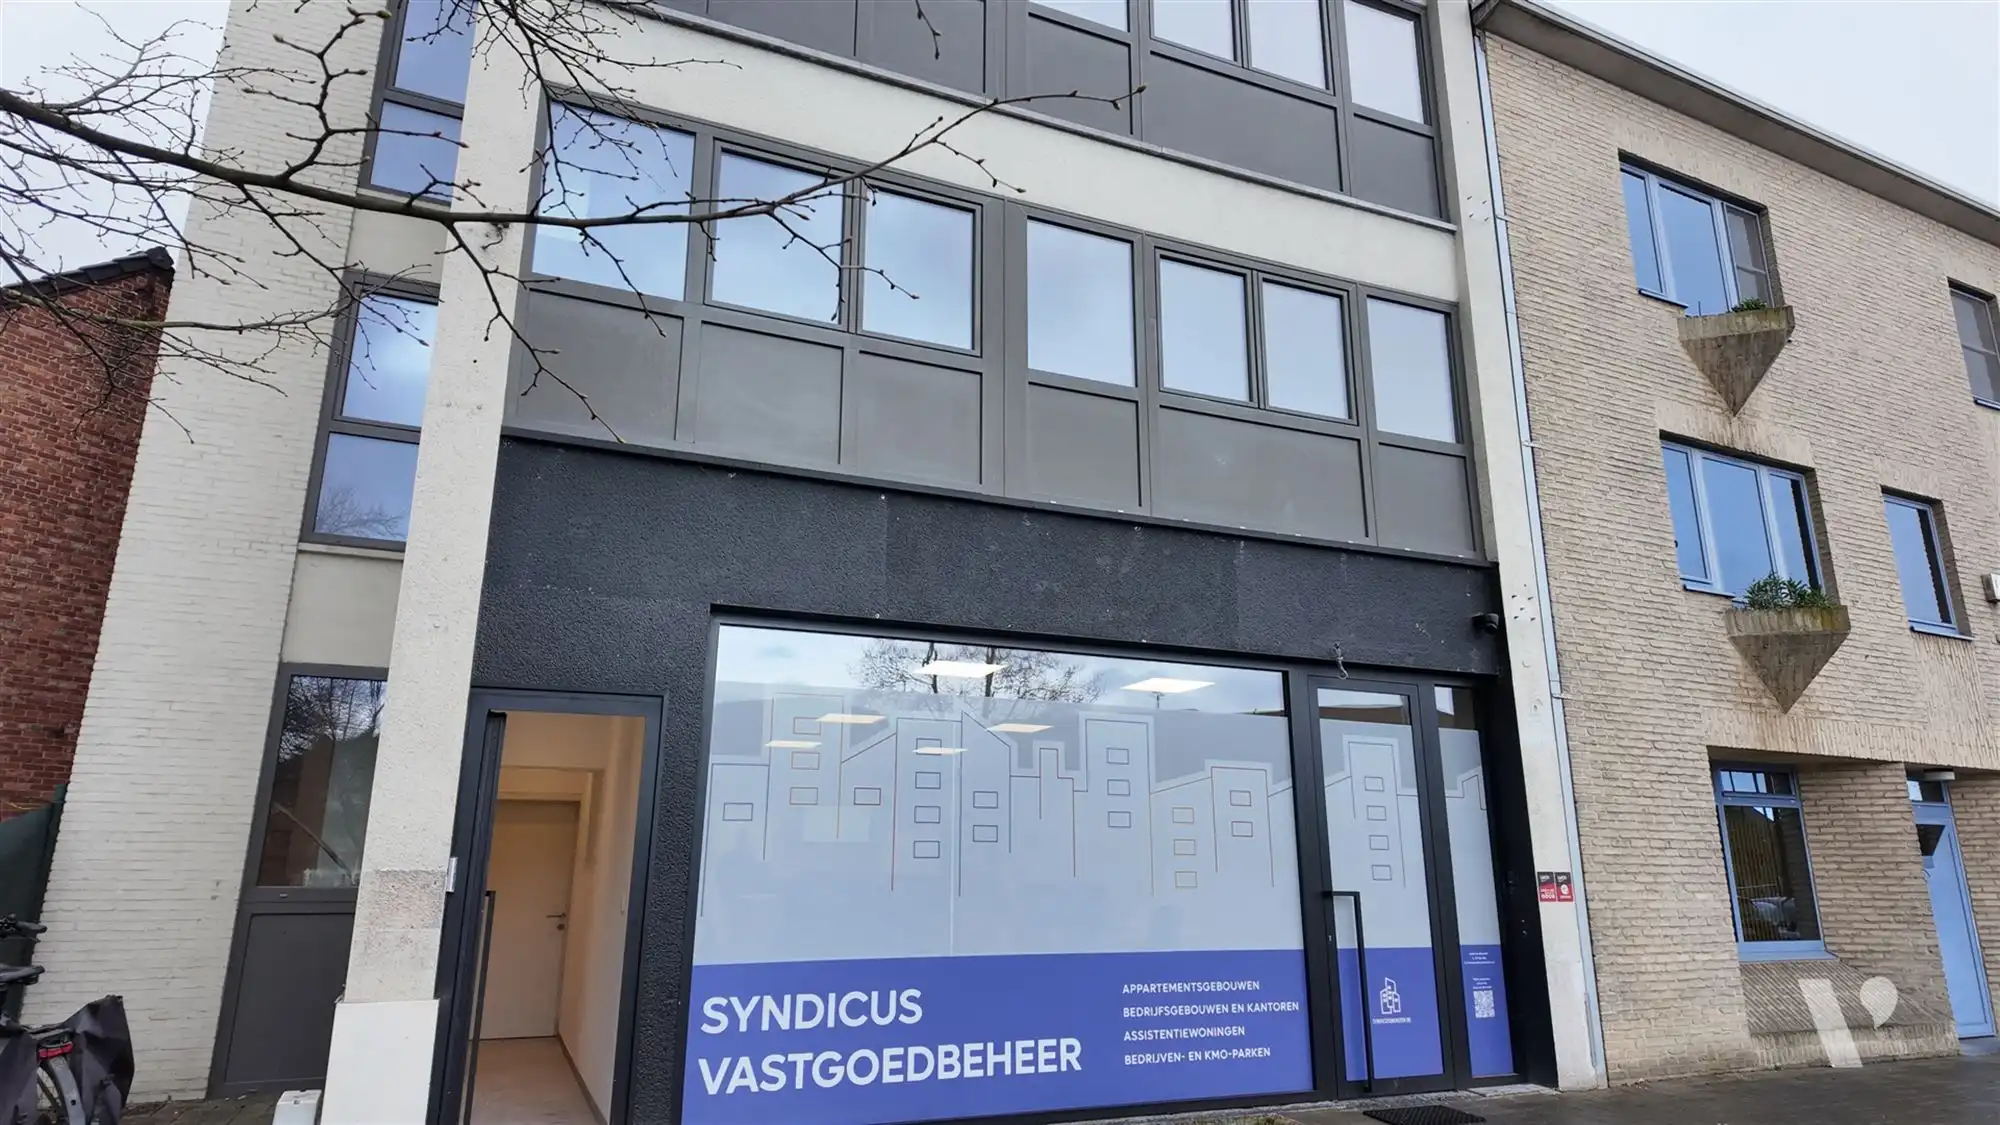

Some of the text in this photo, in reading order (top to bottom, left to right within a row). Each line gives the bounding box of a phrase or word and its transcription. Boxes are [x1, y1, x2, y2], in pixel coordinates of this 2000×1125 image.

[1122, 981, 1260, 994] APPARTEMENTSGEBOUWEN
[701, 988, 923, 1035] SYNDICUS
[1123, 1001, 1299, 1018] BEDRIJFSGEBOUWEN EN KANTOREN
[1124, 1026, 1245, 1042] ASSISTENTIEWONINGEN
[1124, 1047, 1271, 1066] BEDRIJVEN- EN KMO-PARKEN
[698, 1037, 1082, 1095] VASTGOEDBEHEER
